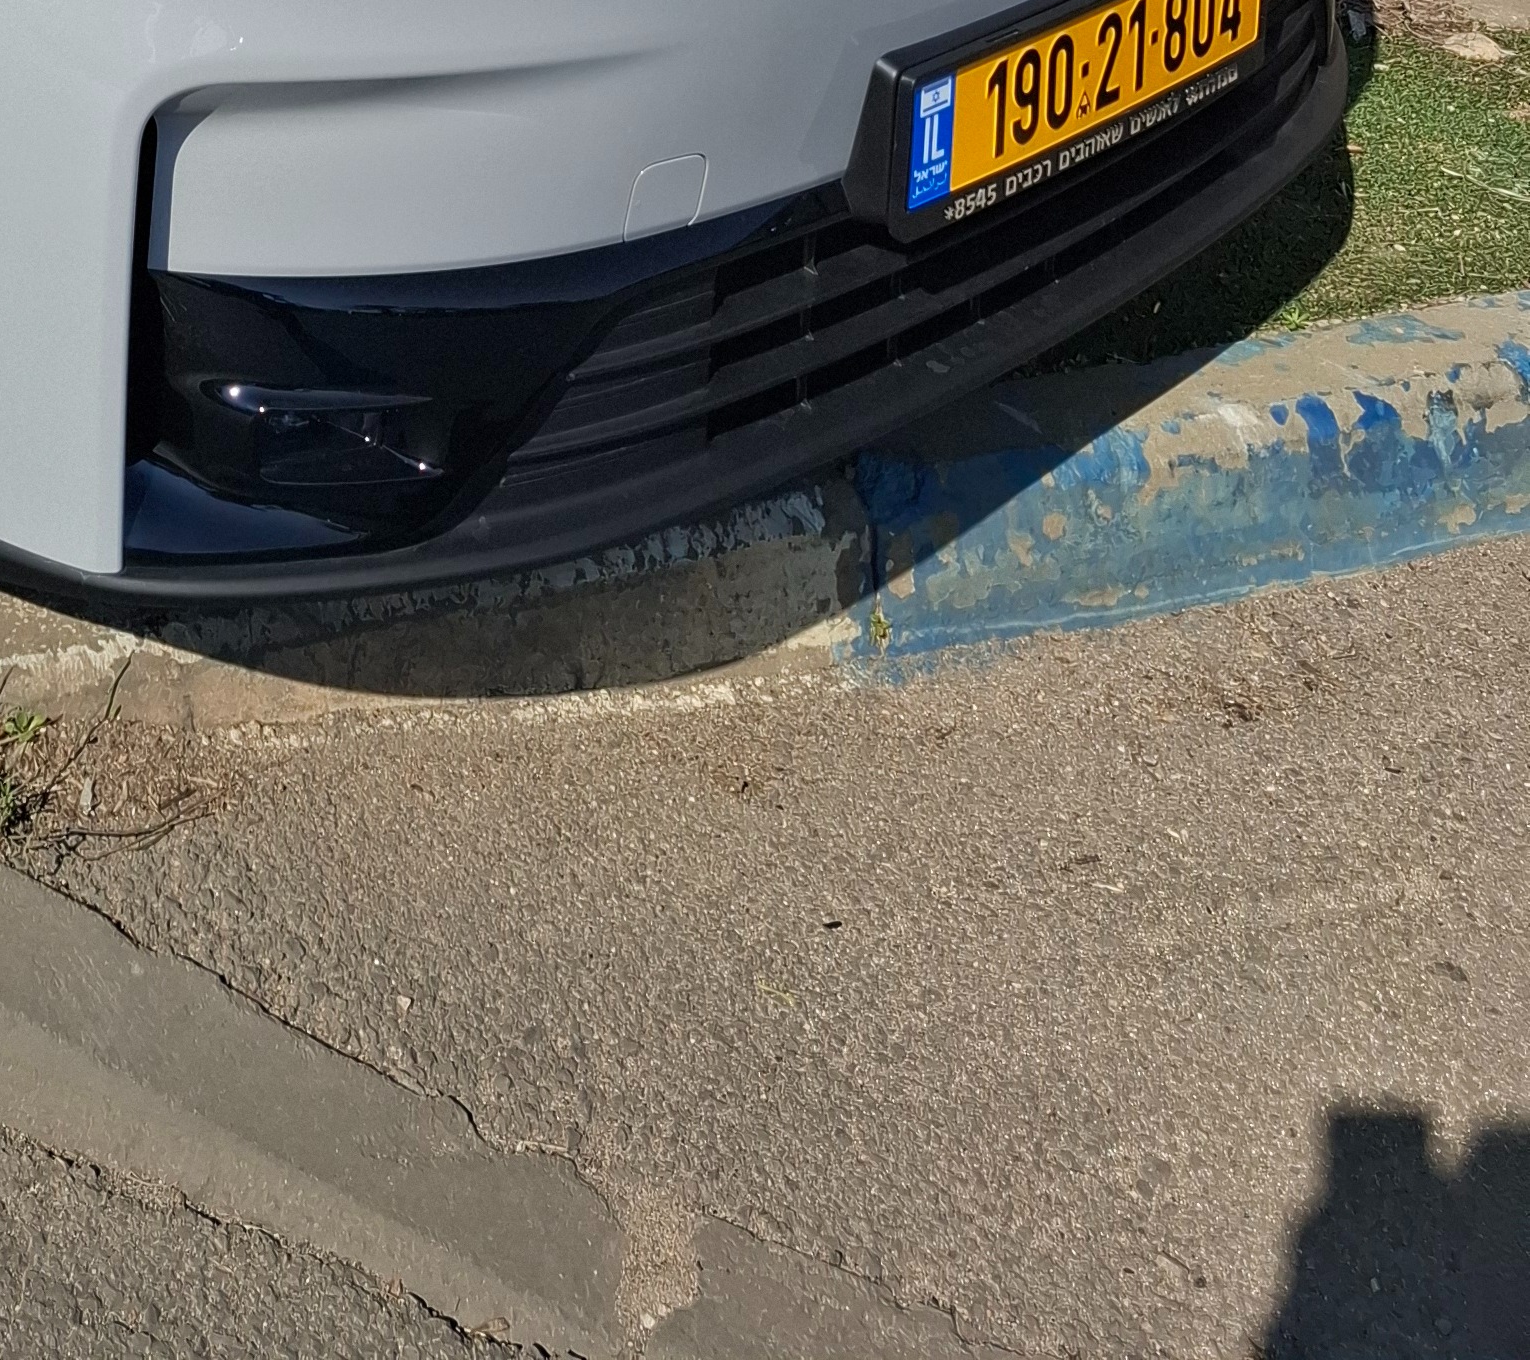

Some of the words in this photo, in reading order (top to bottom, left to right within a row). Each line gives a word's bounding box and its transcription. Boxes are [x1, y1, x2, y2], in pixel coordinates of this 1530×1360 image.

[922, 114, 945, 164] IL
[1058, 122, 1124, 171] שאוהבים
[913, 160, 948, 183] ישראל
[1005, 159, 1052, 197] רכבים
